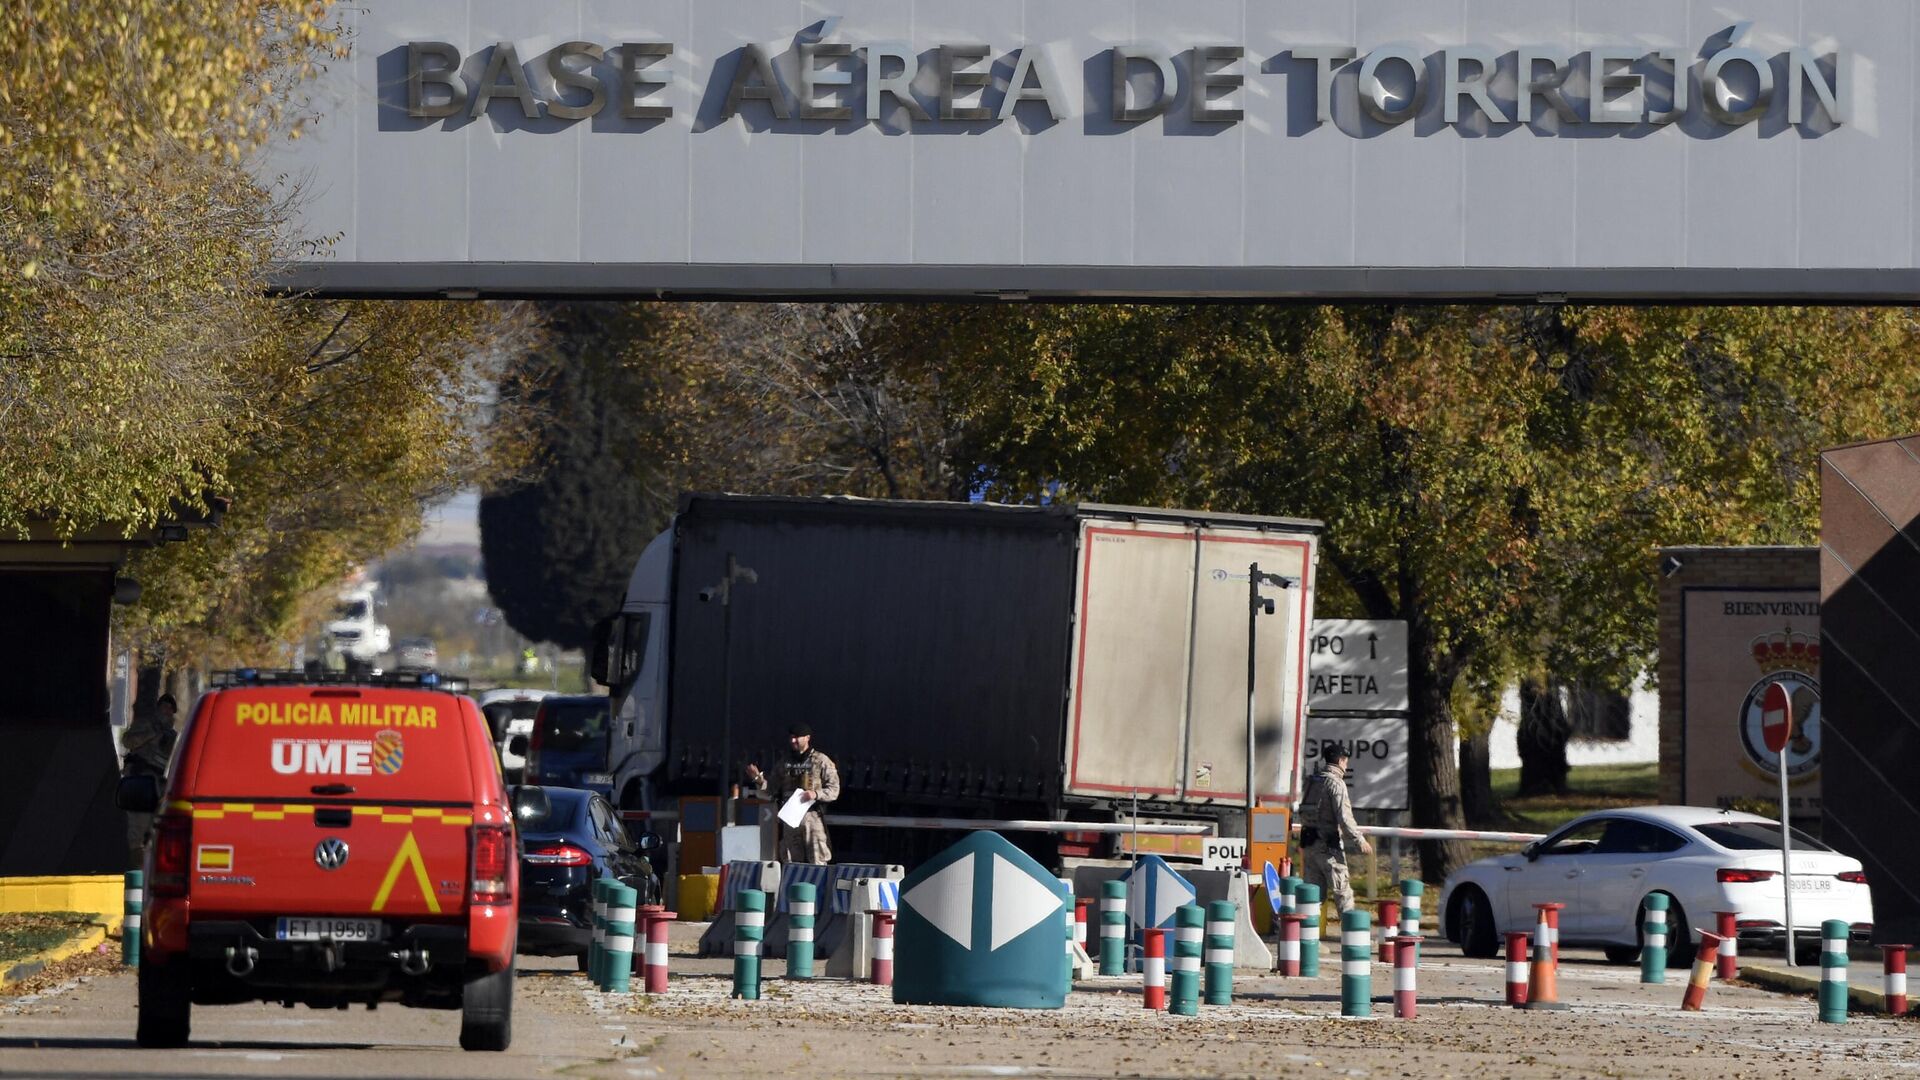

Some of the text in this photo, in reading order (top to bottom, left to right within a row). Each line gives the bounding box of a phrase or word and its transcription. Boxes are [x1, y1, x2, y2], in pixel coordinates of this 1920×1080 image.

[407, 17, 1847, 125] BASE AÉREA DE TORREJÓN
[236, 702, 436, 728] POLICIA MILITAR
[271, 743, 372, 775] UME
[289, 920, 311, 937] ET
